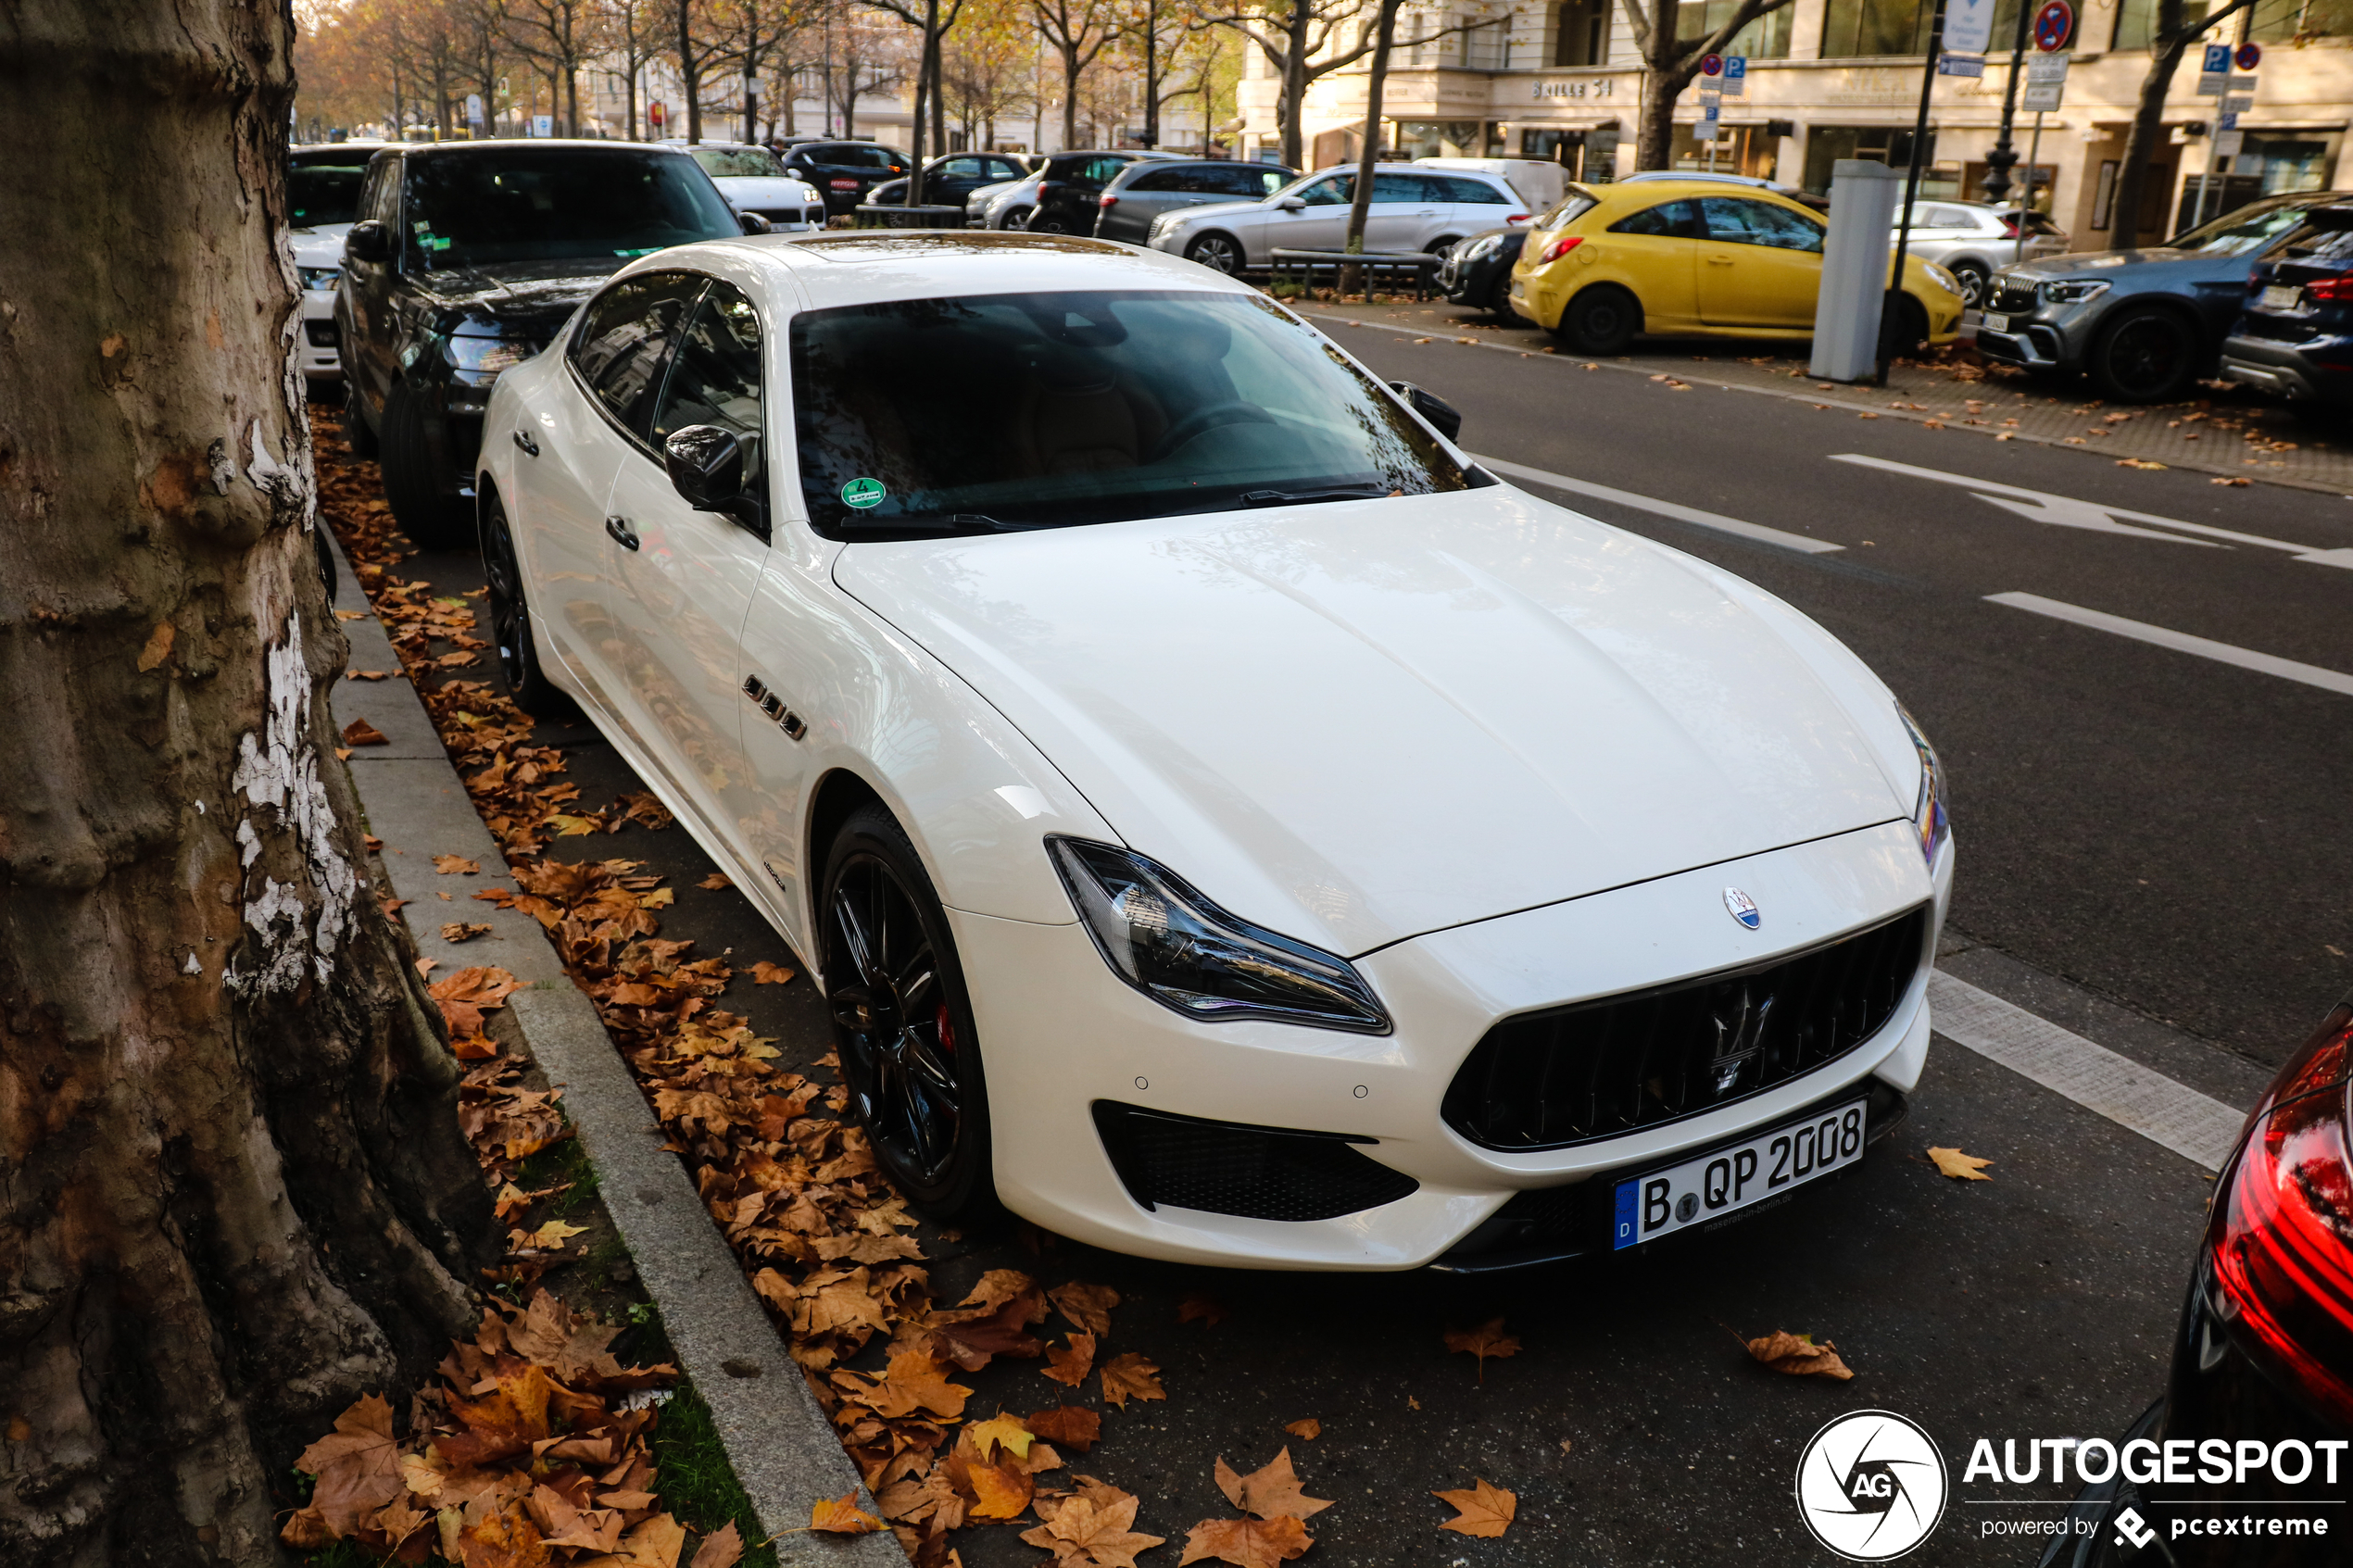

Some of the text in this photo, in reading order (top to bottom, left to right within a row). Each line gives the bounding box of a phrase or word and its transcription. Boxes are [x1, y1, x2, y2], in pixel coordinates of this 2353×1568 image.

[1727, 58, 1741, 75] P
[2205, 47, 2222, 69] P
[1592, 79, 1613, 97] 54
[1642, 1108, 1862, 1234] B QP 2008
[1704, 1192, 1793, 1235] maserati-in-berlin.de
[1619, 1222, 1630, 1238] D
